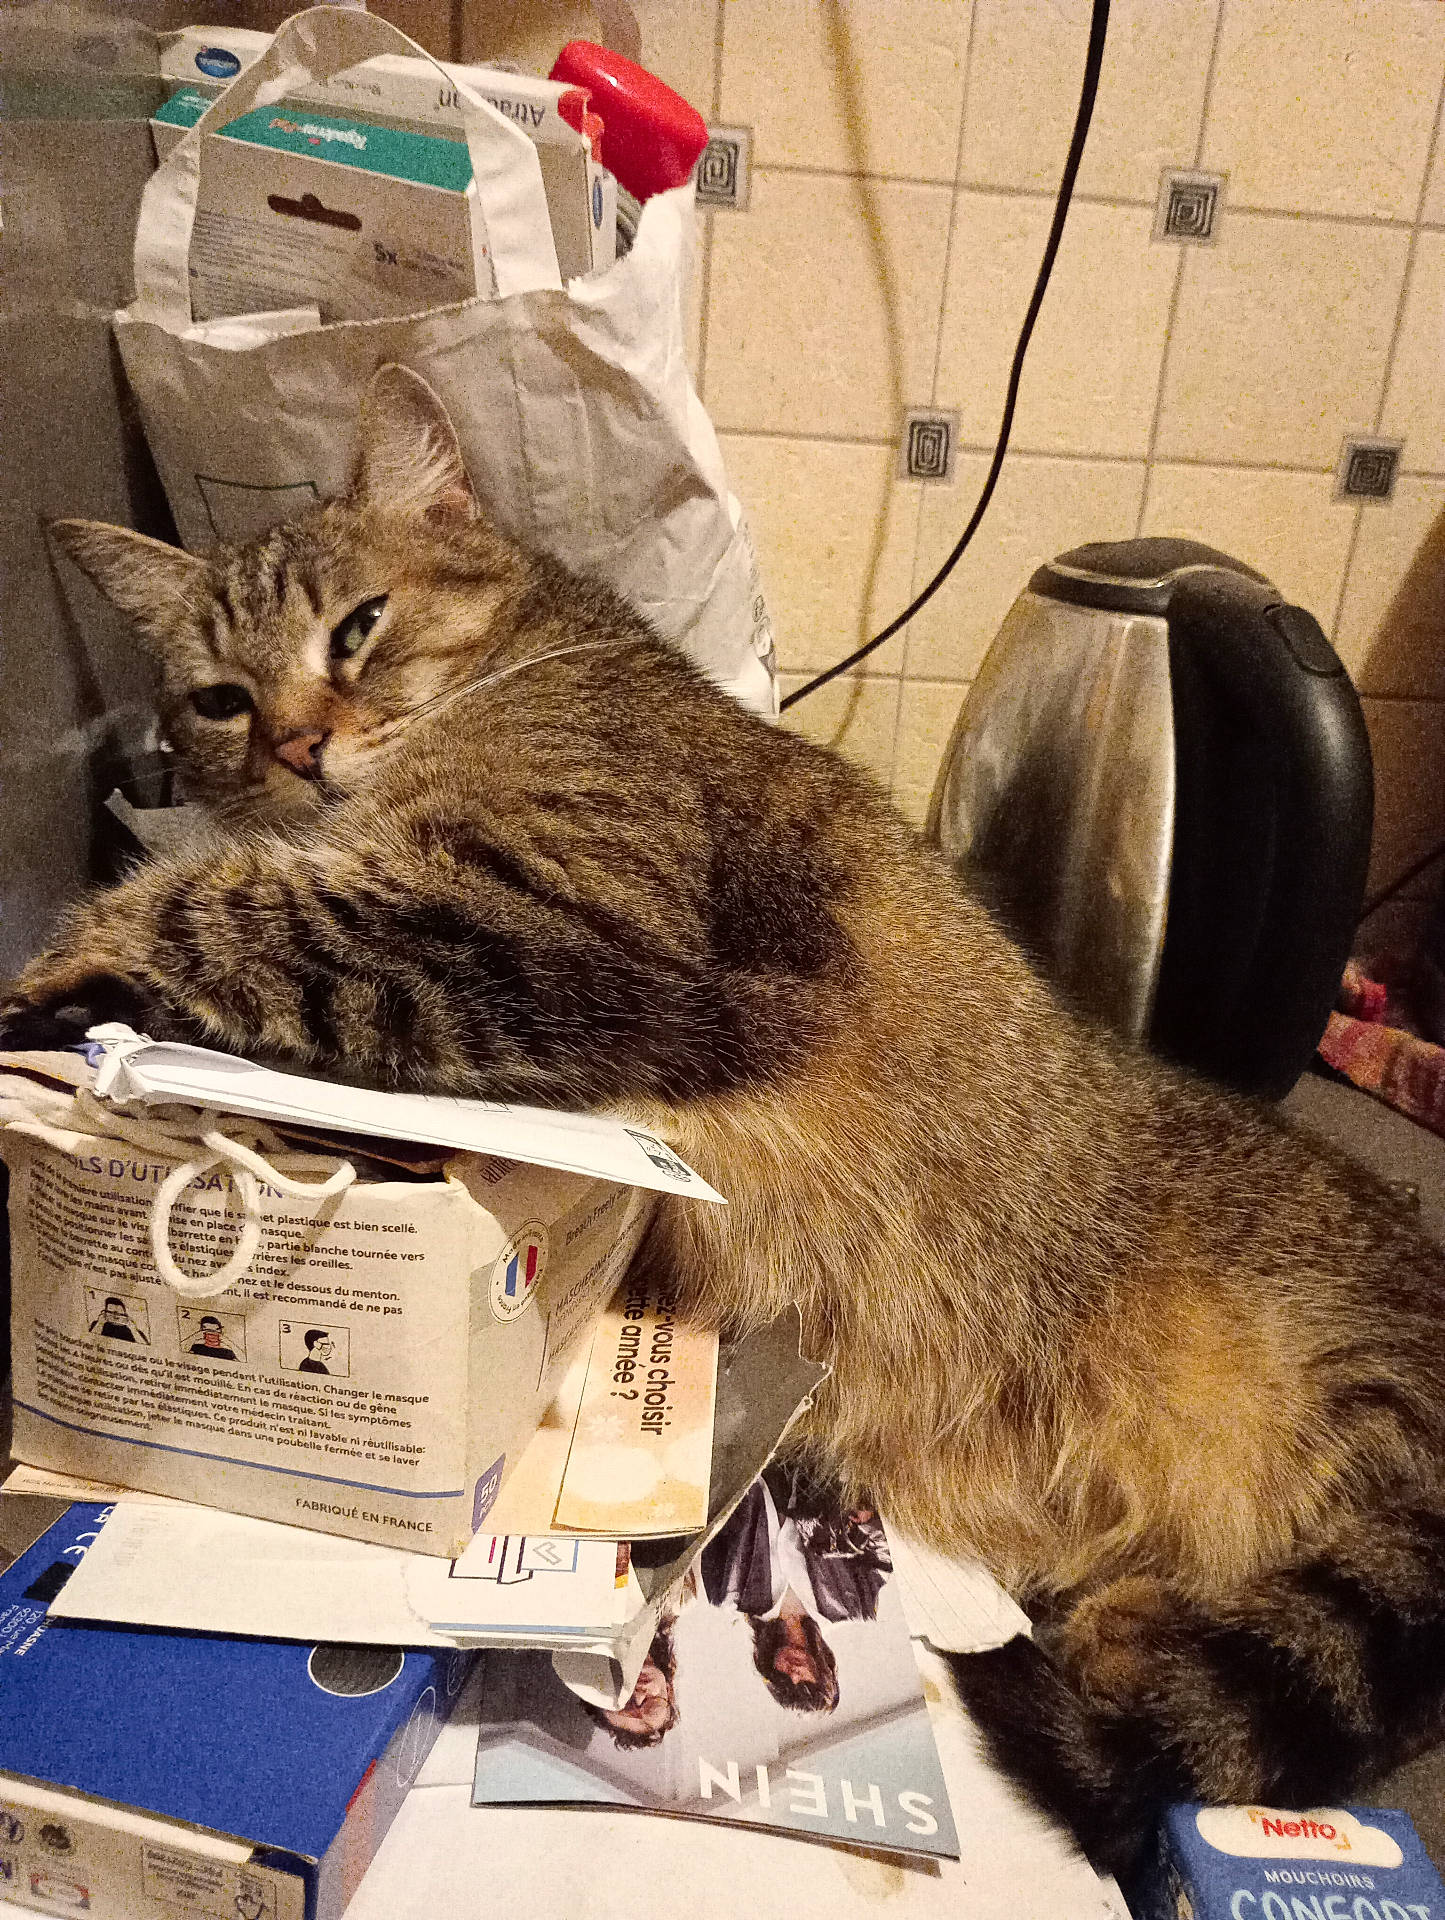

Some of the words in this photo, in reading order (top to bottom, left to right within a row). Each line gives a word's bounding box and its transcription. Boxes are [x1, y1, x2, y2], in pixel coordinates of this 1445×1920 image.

[84, 1200, 115, 1213] mains
[117, 1208, 148, 1219] avant
[190, 1219, 204, 1228] en
[207, 1221, 237, 1232] place
[200, 1207, 222, 1217] que
[224, 1207, 235, 1219] le
[278, 1215, 331, 1228] plastique
[333, 1220, 351, 1231] est
[354, 1221, 379, 1232] bien
[382, 1223, 418, 1235] scellé.
[100, 1215, 116, 1226] sur
[118, 1217, 129, 1229] le
[219, 1236, 233, 1245] en
[267, 1242, 300, 1254] partie
[303, 1243, 349, 1257] blanche
[352, 1248, 398, 1260] tournée
[400, 1252, 425, 1261] vers
[120, 1231, 134, 1242] les
[180, 1241, 235, 1257] élastiques
[291, 1255, 306, 1265] les
[309, 1258, 354, 1270] oreilles.
[97, 1254, 139, 1269] masque
[238, 1276, 258, 1286] nez
[260, 1278, 272, 1288] et
[274, 1279, 284, 1290] le
[287, 1282, 332, 1295] dessous
[335, 1285, 349, 1296] du
[352, 1290, 400, 1301] menton.
[110, 1245, 124, 1254] au
[172, 1254, 185, 1264] du
[188, 1257, 207, 1267] nez
[256, 1265, 290, 1277] index.
[110, 1268, 127, 1279] pas
[129, 1272, 162, 1285] ajusté
[244, 1289, 251, 1299] il
[253, 1291, 270, 1301] est
[272, 1294, 347, 1309] recommandé
[350, 1301, 364, 1311] de
[366, 1305, 381, 1314] ne
[383, 1305, 403, 1317] pas
[181, 1309, 191, 1320] 2
[282, 1323, 293, 1334] 3
[613, 1325, 647, 1384] année
[107, 1348, 148, 1364] masque
[149, 1357, 164, 1367] ou
[165, 1358, 175, 1368] le
[175, 1361, 210, 1375] visage
[213, 1367, 257, 1382] pendant
[324, 1384, 369, 1401] Changer
[372, 1390, 382, 1401] le
[385, 1393, 430, 1406] masque
[115, 1361, 129, 1370] ou
[130, 1363, 149, 1375] dès
[174, 1373, 191, 1382] est
[238, 1381, 251, 1392] En
[253, 1386, 271, 1396] cas
[273, 1388, 287, 1399] de
[289, 1391, 334, 1406] réaction
[336, 1399, 350, 1408] ou
[353, 1400, 367, 1410] de
[369, 1402, 397, 1414] gêne
[123, 1396, 139, 1408] par
[141, 1399, 155, 1409] les
[213, 1413, 227, 1424] Ce
[228, 1416, 267, 1431] produit
[270, 1424, 294, 1435] n'est
[297, 1427, 307, 1437] ni
[310, 1429, 347, 1444] lavable
[351, 1436, 360, 1446] ni
[127, 1385, 208, 1408] immédiatement
[211, 1402, 239, 1413] votre
[241, 1406, 286, 1422] médecin
[139, 1377, 171, 1390] retirer
[174, 1383, 257, 1405] immédiatement
[260, 1397, 269, 1407] le
[272, 1400, 316, 1416] masque.
[318, 1406, 328, 1417] Si
[330, 1409, 346, 1420] les
[348, 1413, 412, 1429] symptômes
[641, 1368, 676, 1435] choisir
[147, 1412, 171, 1425] jeter
[173, 1415, 183, 1425] le
[185, 1419, 225, 1435] masque
[228, 1425, 251, 1438] dans
[254, 1432, 274, 1442] une
[277, 1436, 322, 1451] poubelle
[324, 1443, 363, 1458] fermée
[365, 1450, 376, 1460] et
[379, 1453, 391, 1463] se
[393, 1455, 420, 1467] laver
[480, 1474, 498, 1504] 50
[296, 1499, 359, 1519] FABRIQUÉ
[362, 1511, 379, 1524] EN
[382, 1515, 433, 1532] FRANCE
[699, 1755, 939, 1836] SHEIN
[1261, 1818, 1337, 1840] Netto
[1264, 1869, 1375, 1889] MOUCHOIRS
